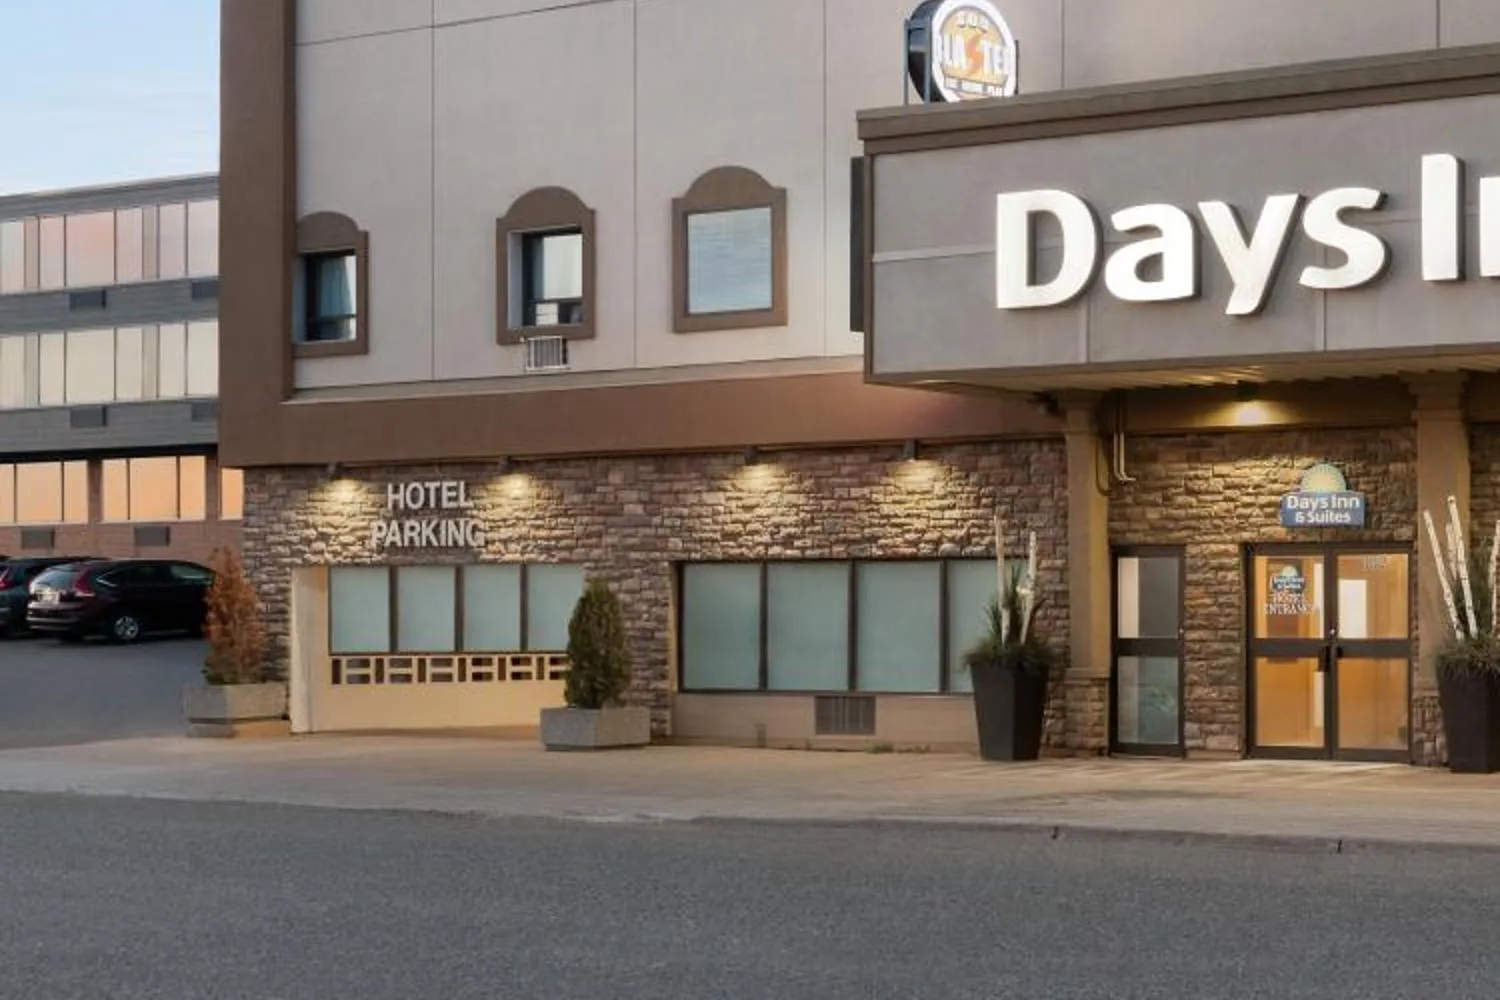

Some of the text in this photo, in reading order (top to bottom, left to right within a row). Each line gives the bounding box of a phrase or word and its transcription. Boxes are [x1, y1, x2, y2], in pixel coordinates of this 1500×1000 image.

[997, 188, 1388, 315] Days
[387, 481, 474, 510] HOTEL
[1286, 494, 1360, 512] Days Inn
[1307, 510, 1351, 523] Suites
[371, 518, 485, 548] PARKING
